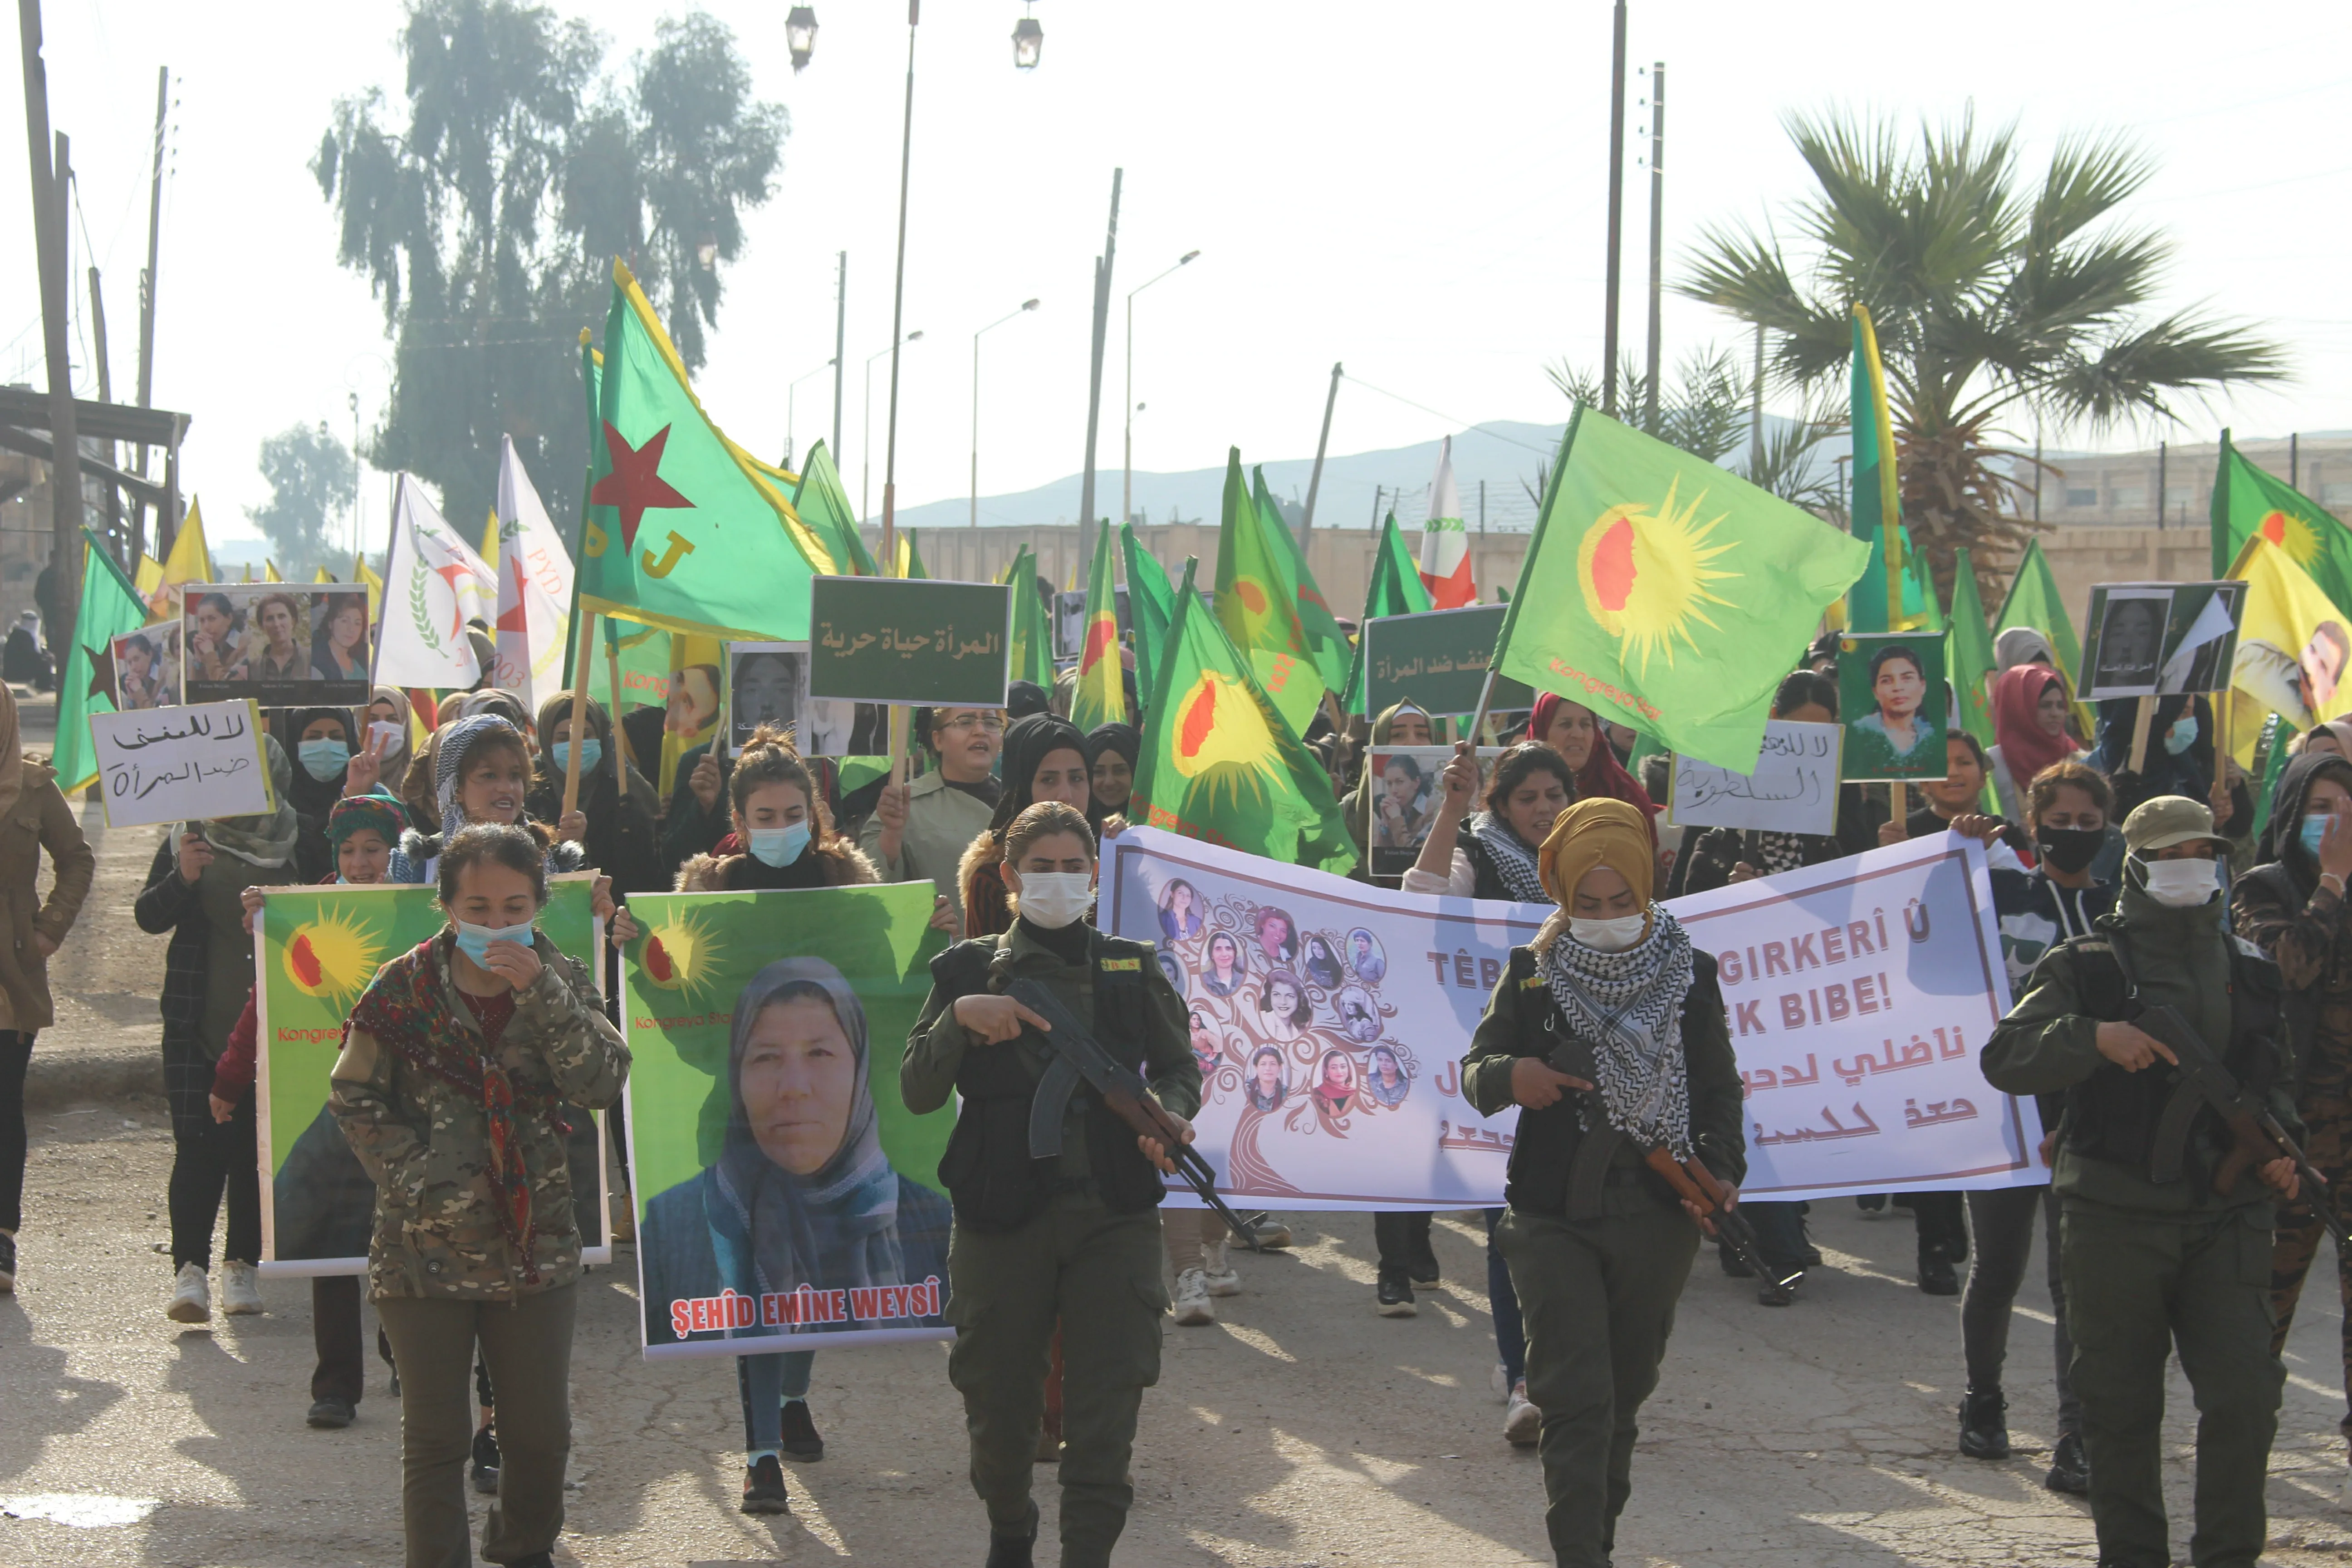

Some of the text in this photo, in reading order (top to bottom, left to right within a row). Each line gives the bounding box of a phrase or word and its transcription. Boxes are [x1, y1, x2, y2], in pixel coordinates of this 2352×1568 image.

[527, 547, 562, 594] PYD
[820, 622, 998, 660] المرأة حياة حرية
[482, 653, 525, 688] 003
[622, 670, 670, 699] Kong
[1377, 654, 1423, 683] المرأة
[1548, 657, 1635, 707] Kongreya
[113, 714, 244, 750] لا للعنف
[1810, 735, 1828, 757] لا
[106, 758, 249, 800] ضد المرأة
[1426, 897, 1931, 991] TÊB GIRKERÎ Û
[1779, 972, 1892, 1030] BIBE!
[635, 1015, 705, 1031] Kongreya
[1833, 1025, 1966, 1086] ناضلي
[671, 1275, 941, 1338] ŞEHÎD EMÎNE WEYSÎ
